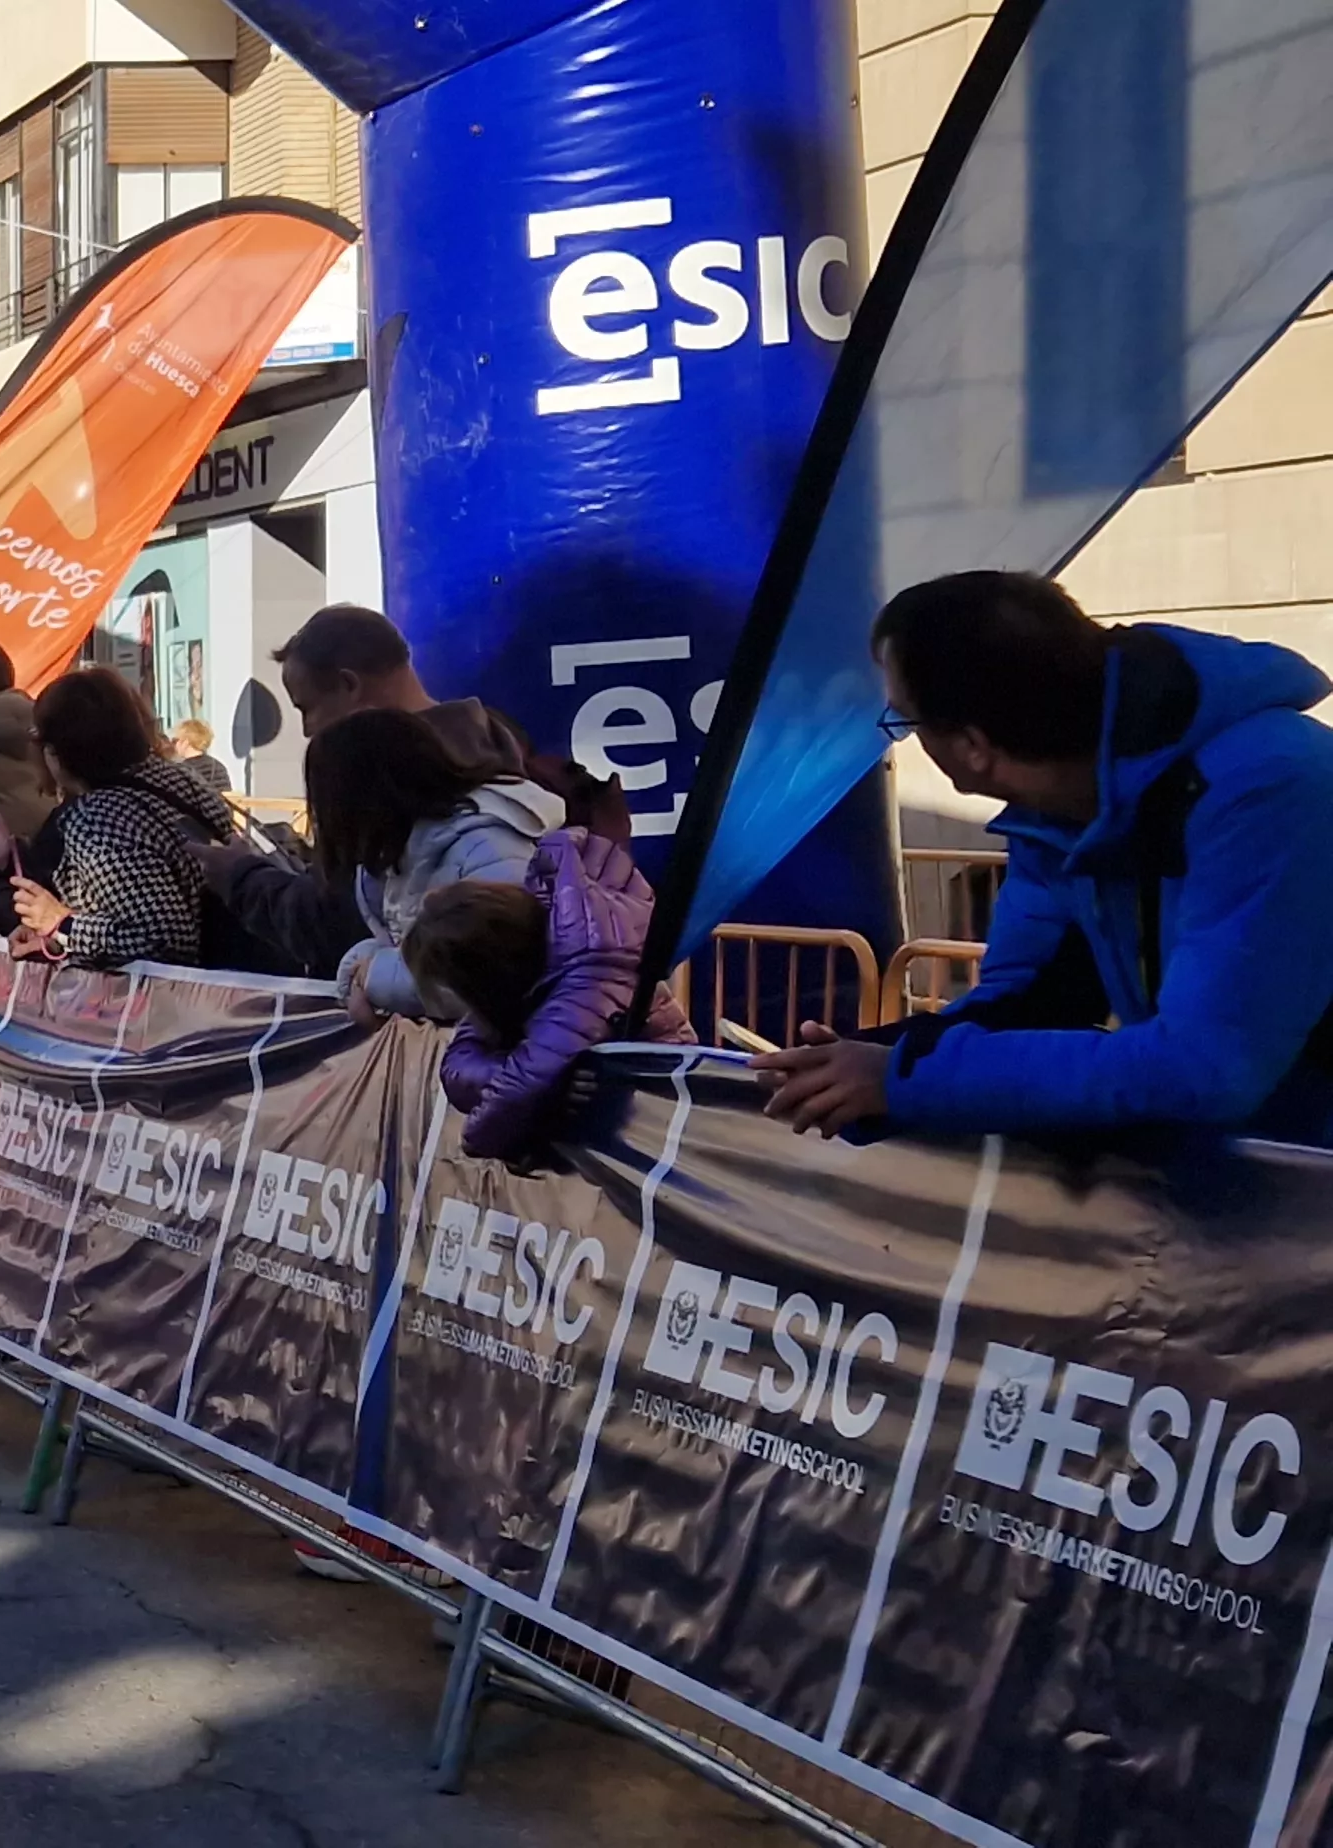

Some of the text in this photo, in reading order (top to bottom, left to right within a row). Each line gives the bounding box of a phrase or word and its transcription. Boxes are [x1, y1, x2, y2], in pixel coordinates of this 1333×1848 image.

[145, 351, 201, 399] Huesca
[6, 1087, 83, 1176] ESIC
[124, 1120, 221, 1221] ESIC
[275, 1158, 386, 1273] ESIC
[463, 1207, 605, 1344] ESIC
[699, 1274, 899, 1438] ESIC
[1032, 1361, 1302, 1565] ESIC
